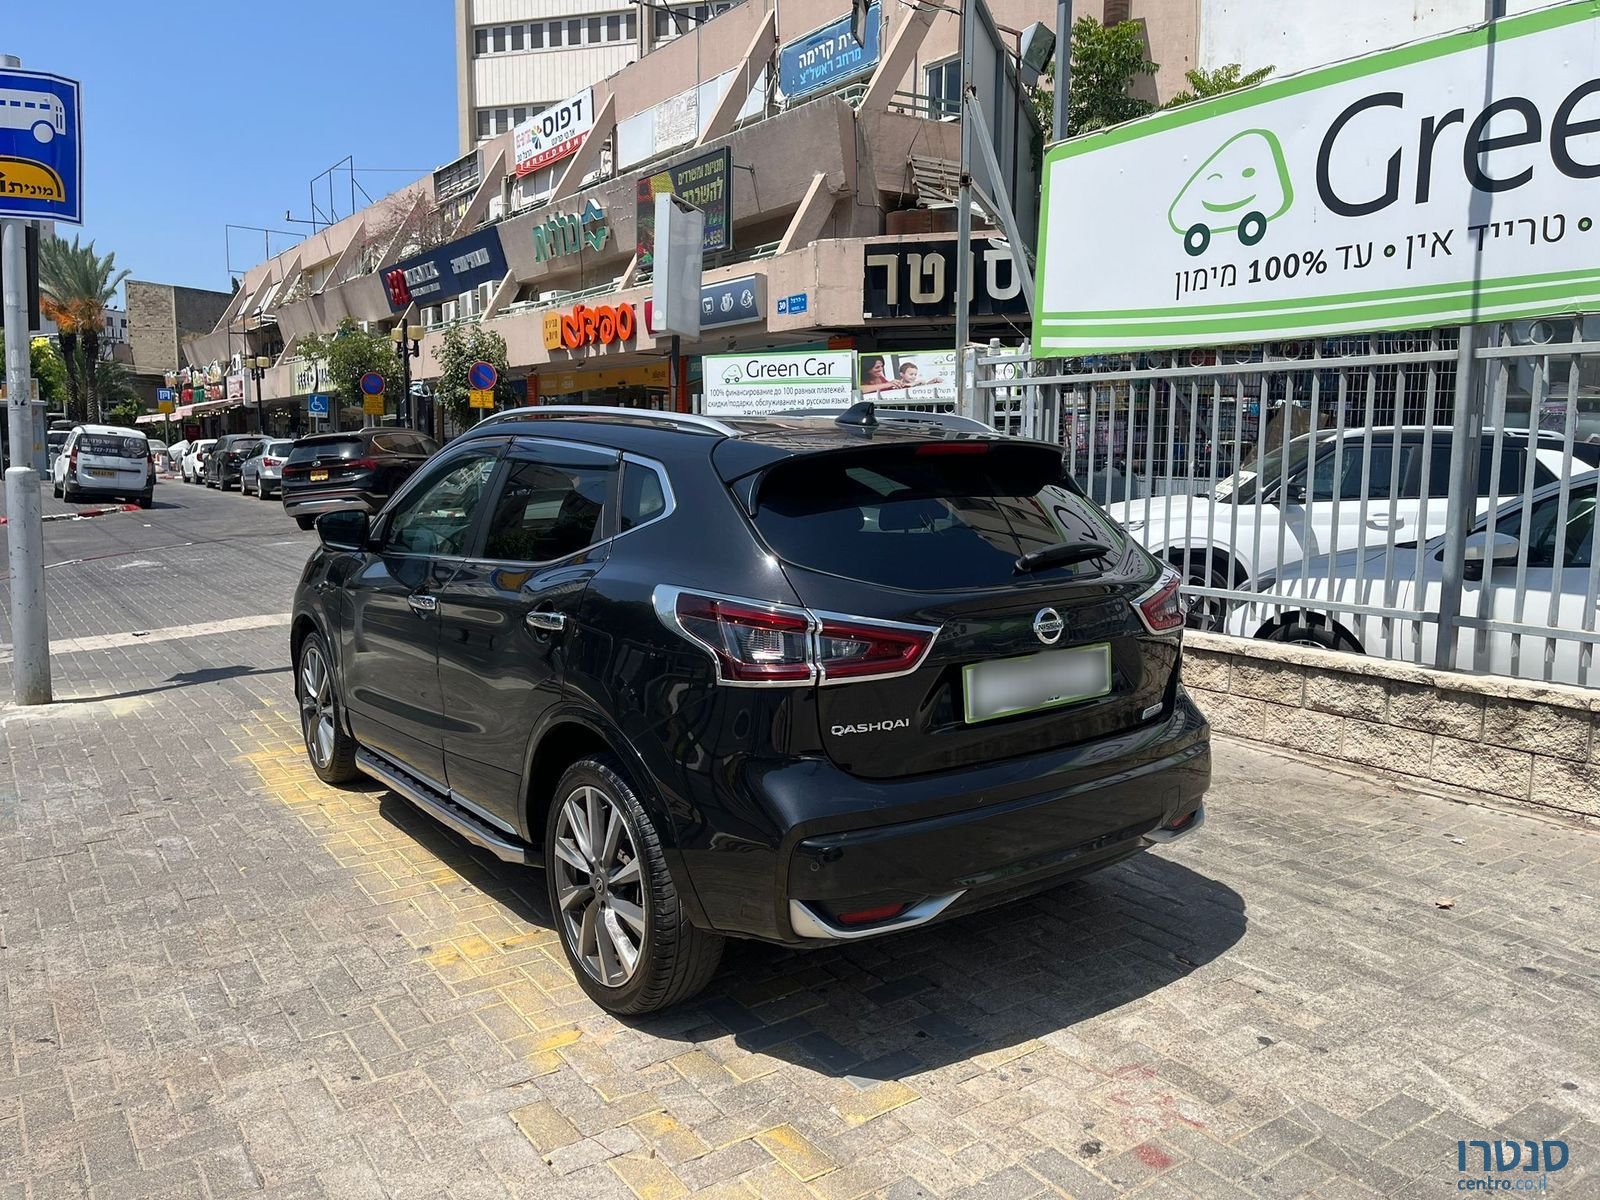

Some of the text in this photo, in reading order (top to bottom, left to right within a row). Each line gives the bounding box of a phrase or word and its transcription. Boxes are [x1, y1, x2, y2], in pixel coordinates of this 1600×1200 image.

[799, 39, 834, 69] קדימה
[835, 48, 862, 69] מרחב
[543, 98, 582, 138] דפוס
[8, 181, 54, 196] מונית
[532, 211, 580, 263] כללית
[1175, 213, 1566, 300] טרייד אין עד 100% מימון
[778, 301, 787, 311] 30
[746, 357, 835, 378] Green Car
[710, 388, 724, 397] 100%
[725, 387, 774, 398] финансирование
[783, 386, 793, 395] 100
[794, 386, 816, 397] равных
[755, 399, 796, 408] обслуживание
[806, 398, 830, 407] русском
[1038, 621, 1062, 631] NISSAN
[830, 718, 910, 737] QASHQAI
